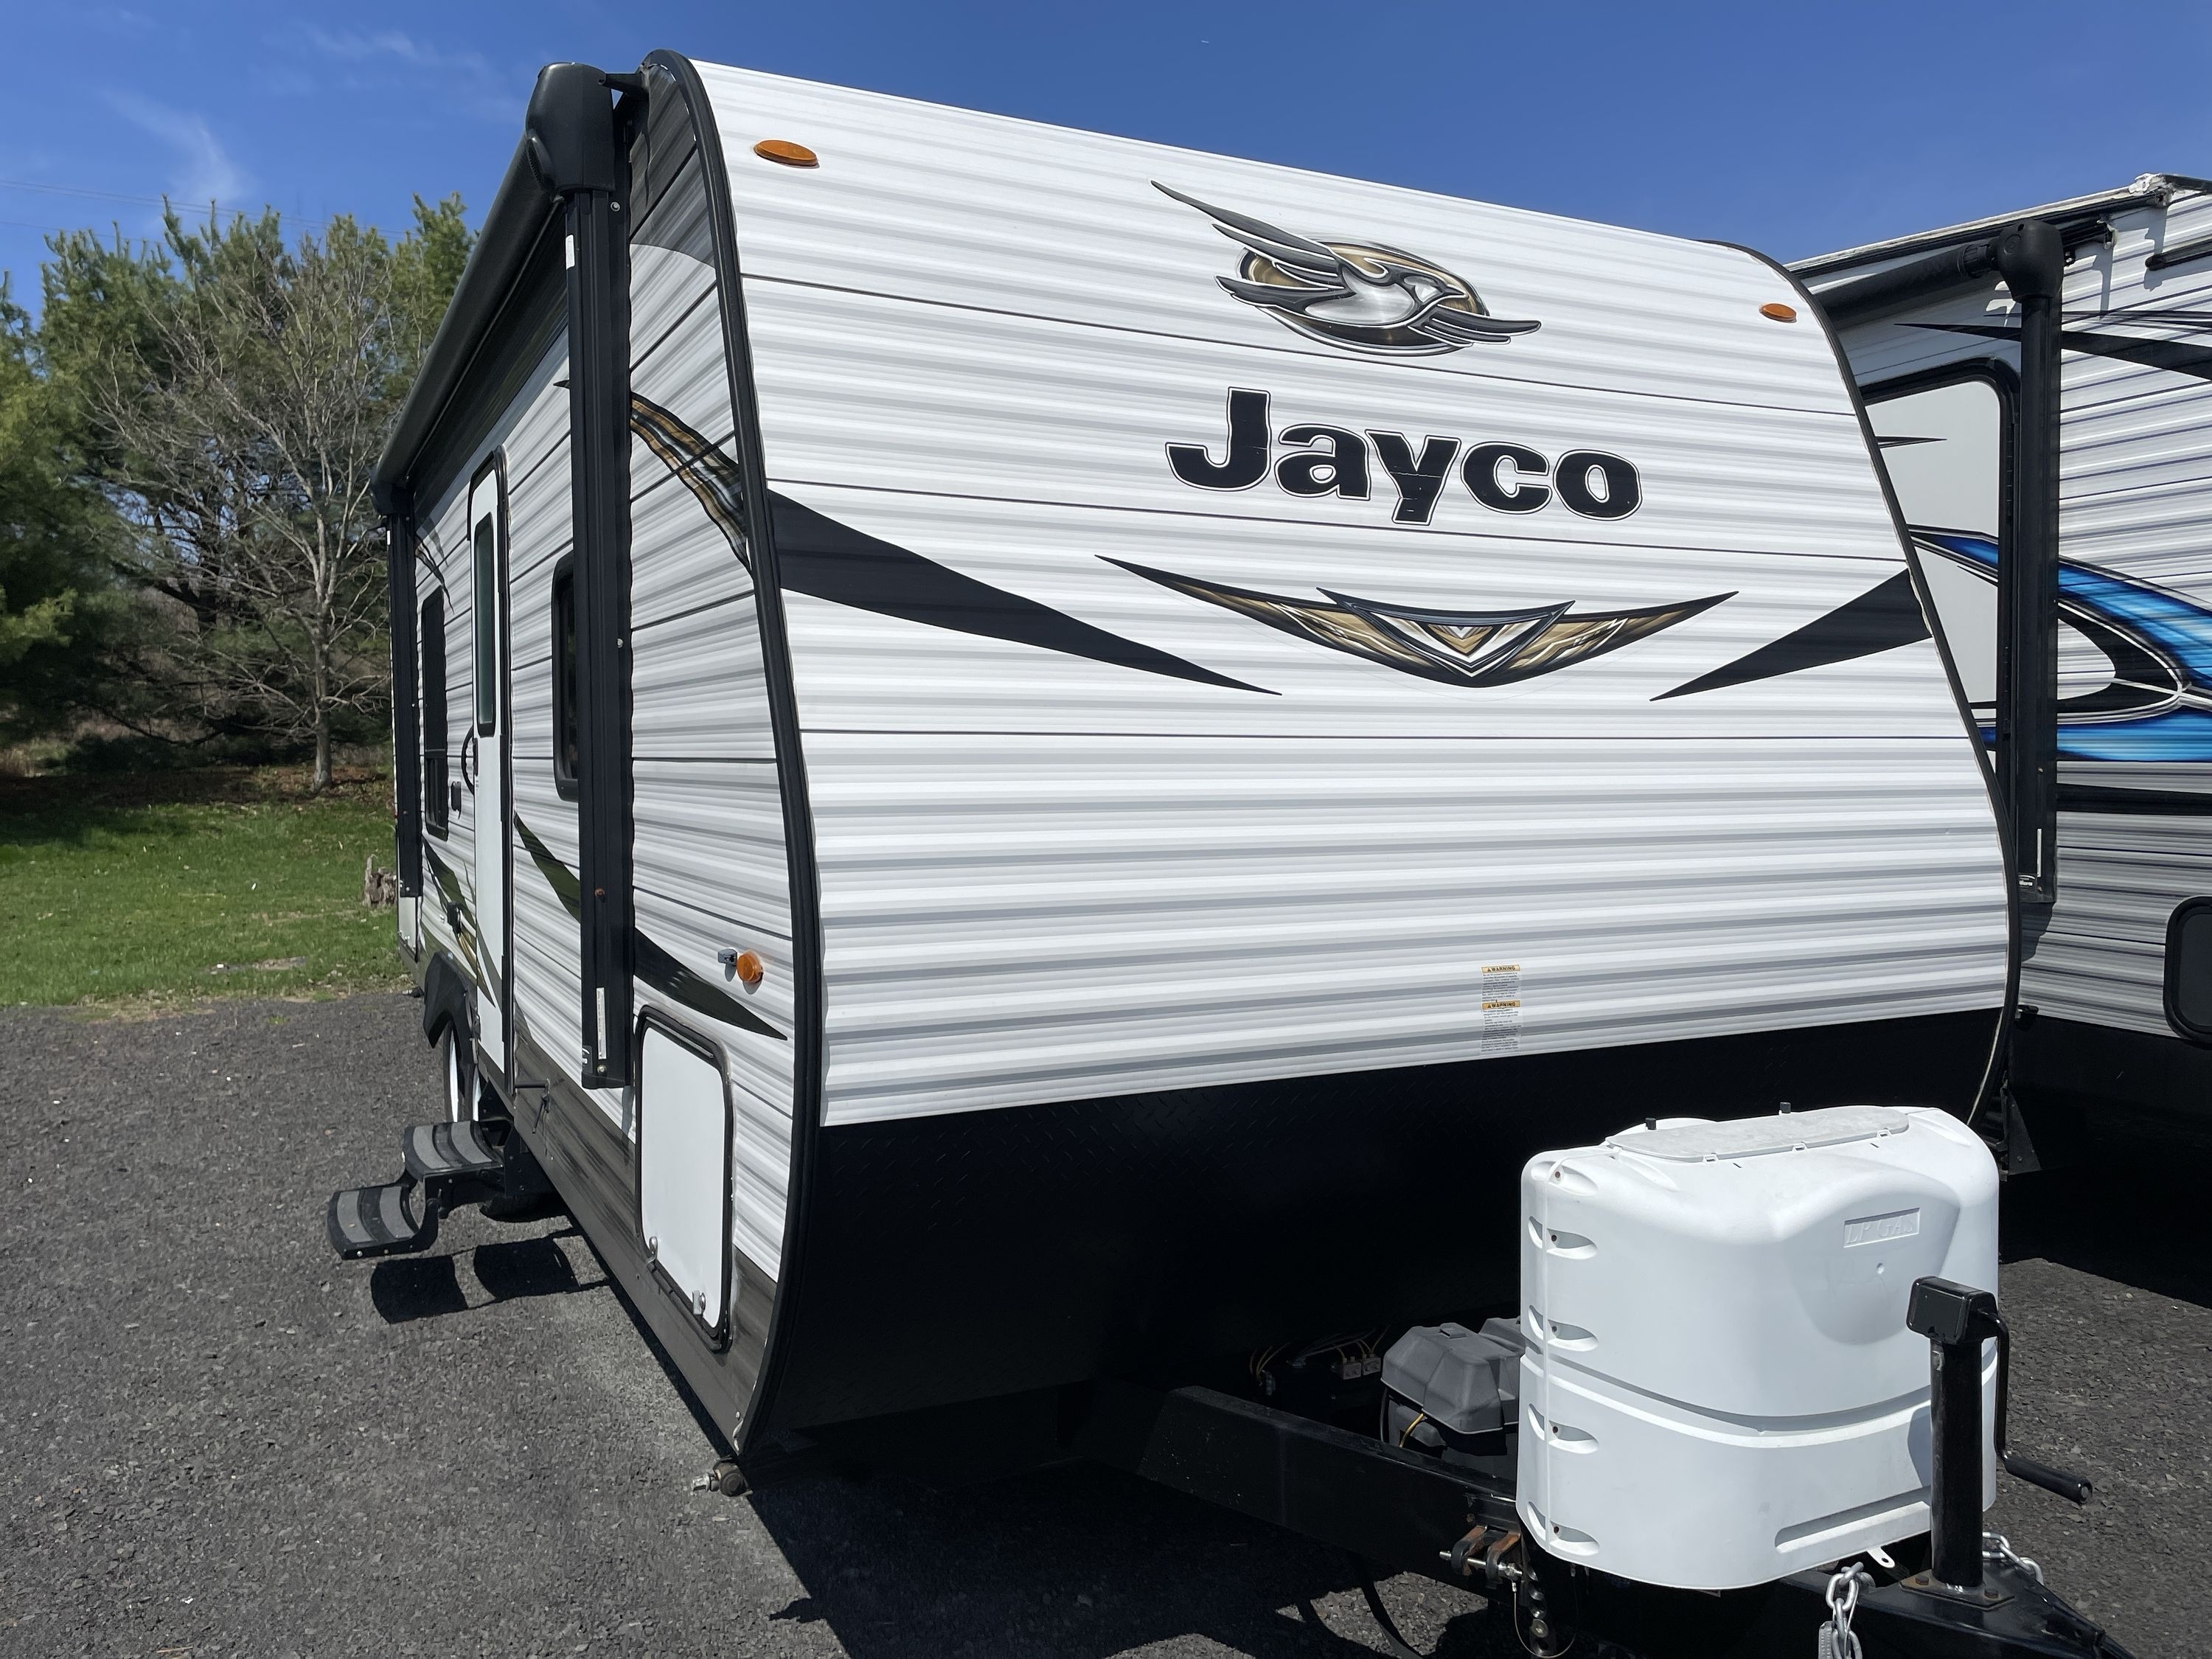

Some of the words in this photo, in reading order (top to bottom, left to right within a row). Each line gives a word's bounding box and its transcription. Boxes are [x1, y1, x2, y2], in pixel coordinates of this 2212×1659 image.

[1165, 386, 1642, 526] Jayco
[1846, 1222, 1871, 1244] LP
[1877, 1215, 1913, 1237] GAS
